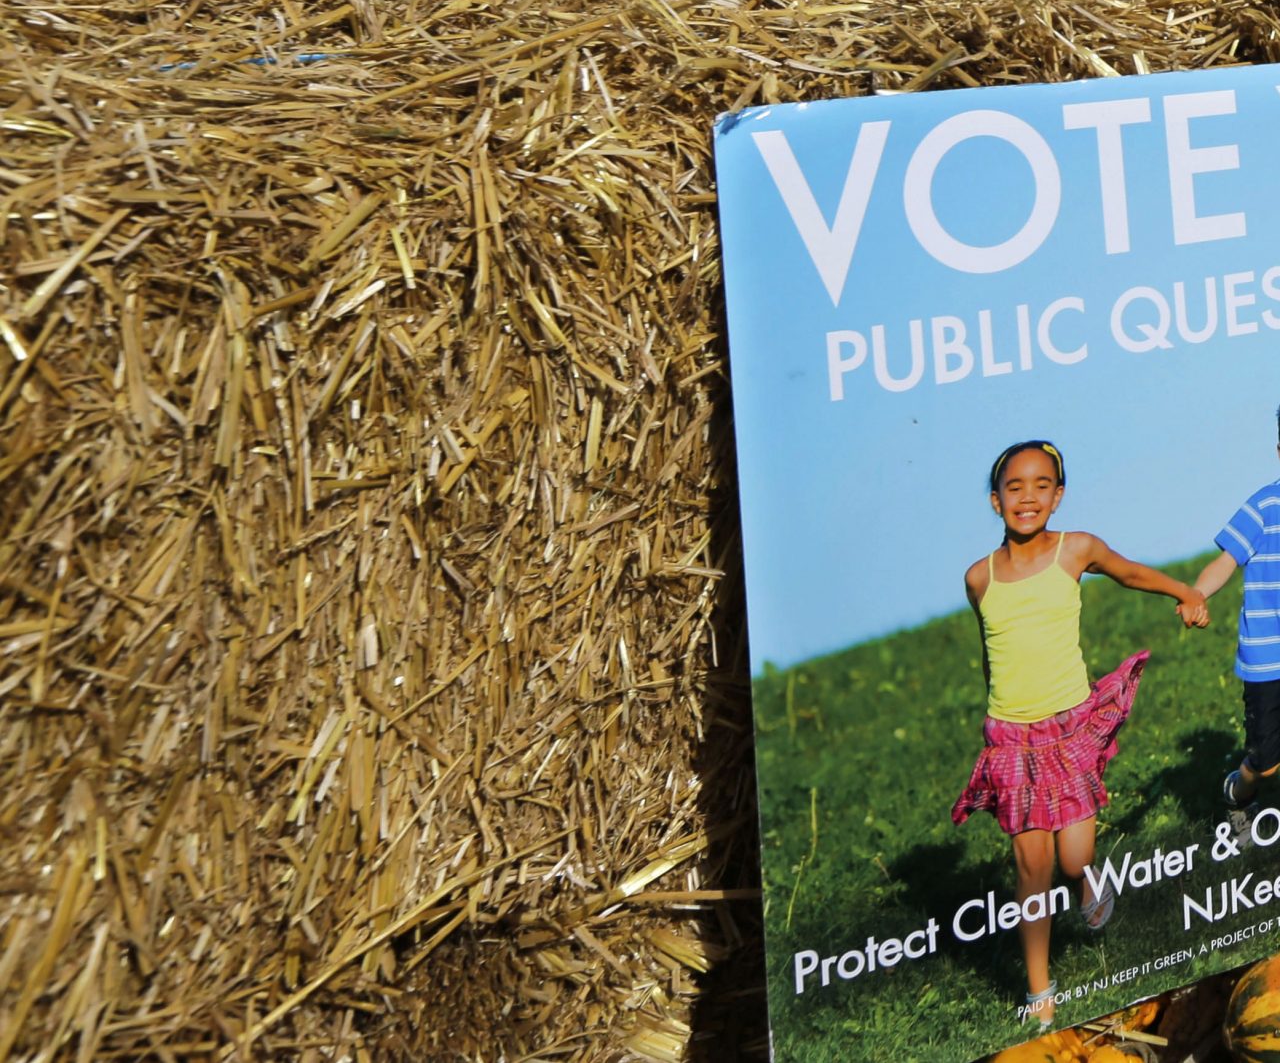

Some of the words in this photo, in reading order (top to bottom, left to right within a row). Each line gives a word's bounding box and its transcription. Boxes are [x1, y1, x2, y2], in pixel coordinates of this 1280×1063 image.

[751, 89, 1247, 308] VOTE
[826, 296, 1089, 402] PUBLIC
[794, 918, 940, 994] Protect
[952, 886, 1070, 942] Clean
[1083, 843, 1198, 902] Water
[1211, 822, 1240, 862] &
[1017, 1001, 1043, 1018] PAID
[1048, 991, 1072, 1007] FOR
[1075, 984, 1089, 999] BY
[1093, 977, 1109, 992] NJ
[1111, 967, 1139, 985] KEEP
[1141, 962, 1152, 975] IT
[1154, 948, 1196, 971] GREEN,
[1199, 944, 1208, 956] A
[1211, 925, 1256, 951] PROJECT
[1258, 920, 1274, 933] OF
